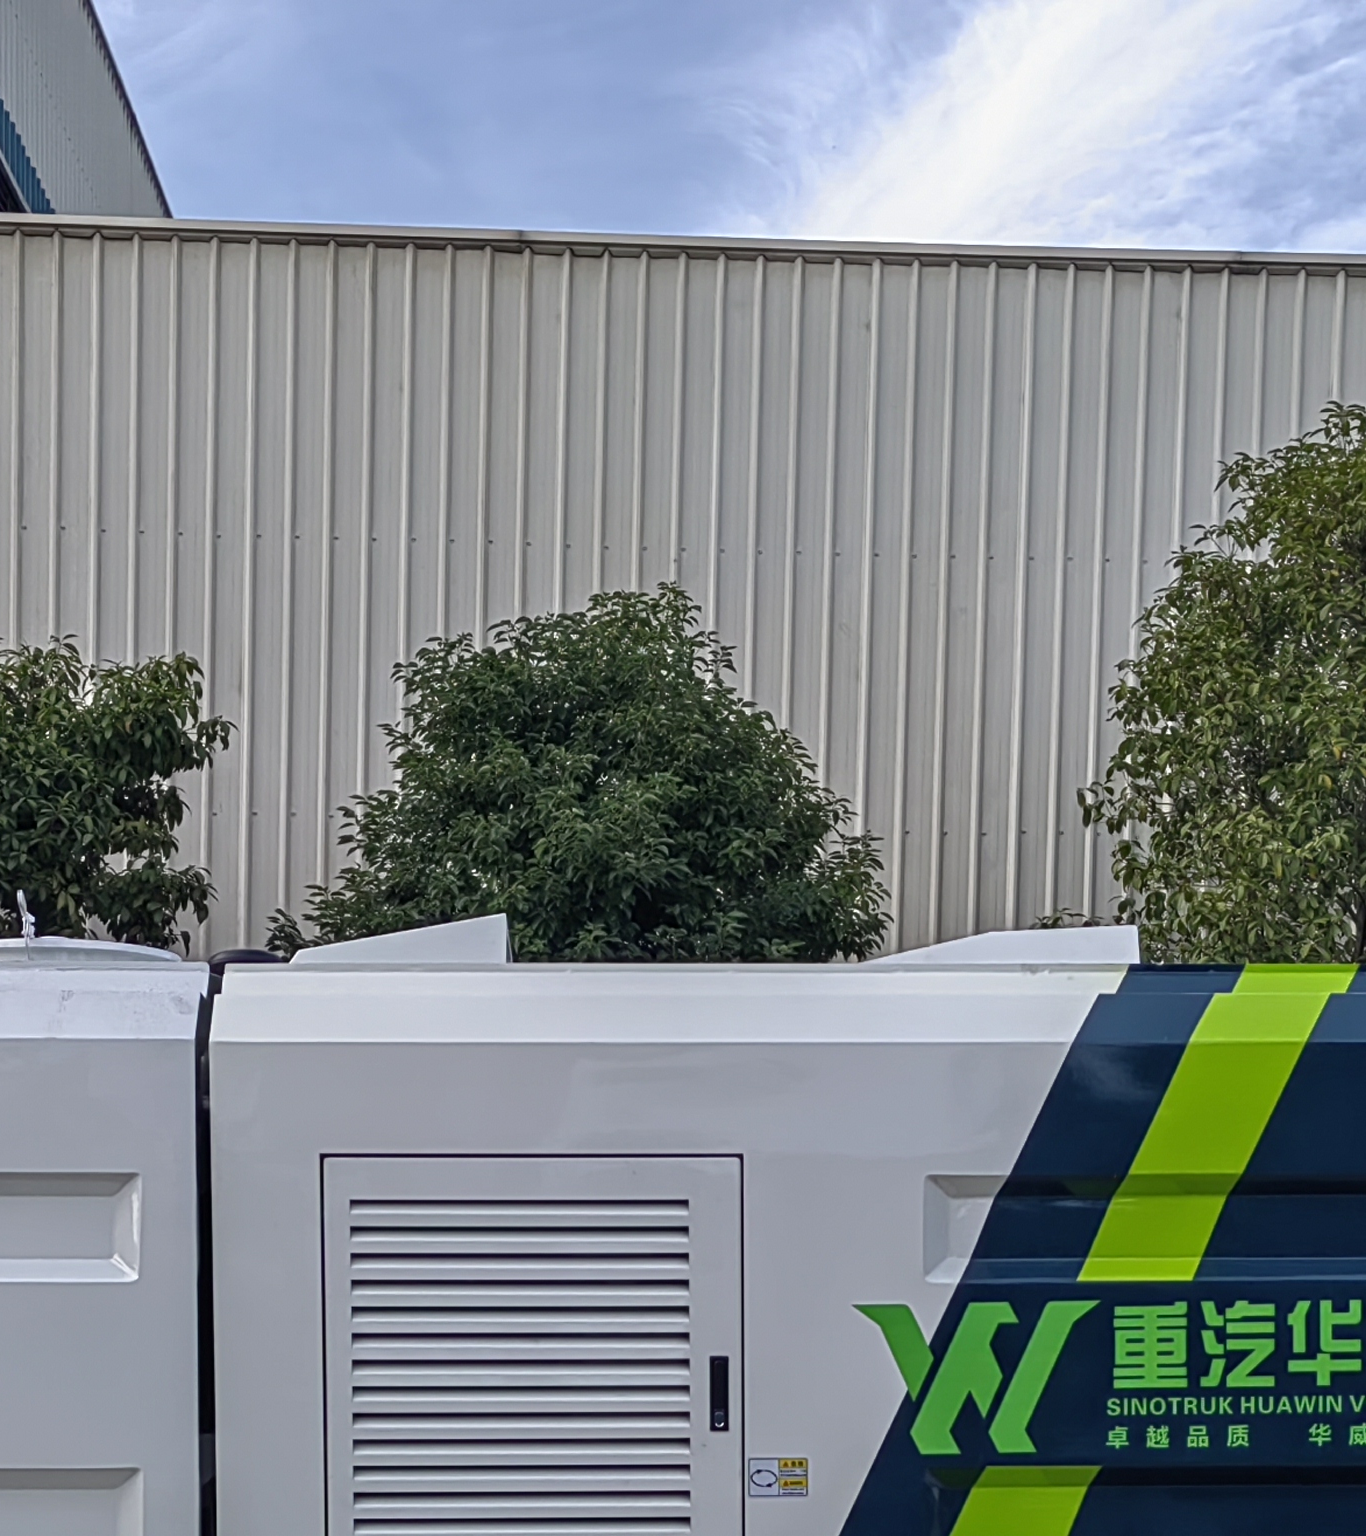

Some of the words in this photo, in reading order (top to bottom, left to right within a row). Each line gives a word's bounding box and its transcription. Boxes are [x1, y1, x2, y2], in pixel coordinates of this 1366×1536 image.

[1106, 1396, 1233, 1416] SINOTRUK
[1240, 1395, 1343, 1415] HUAWIN
[1106, 1424, 1250, 1449] 卓越品质
